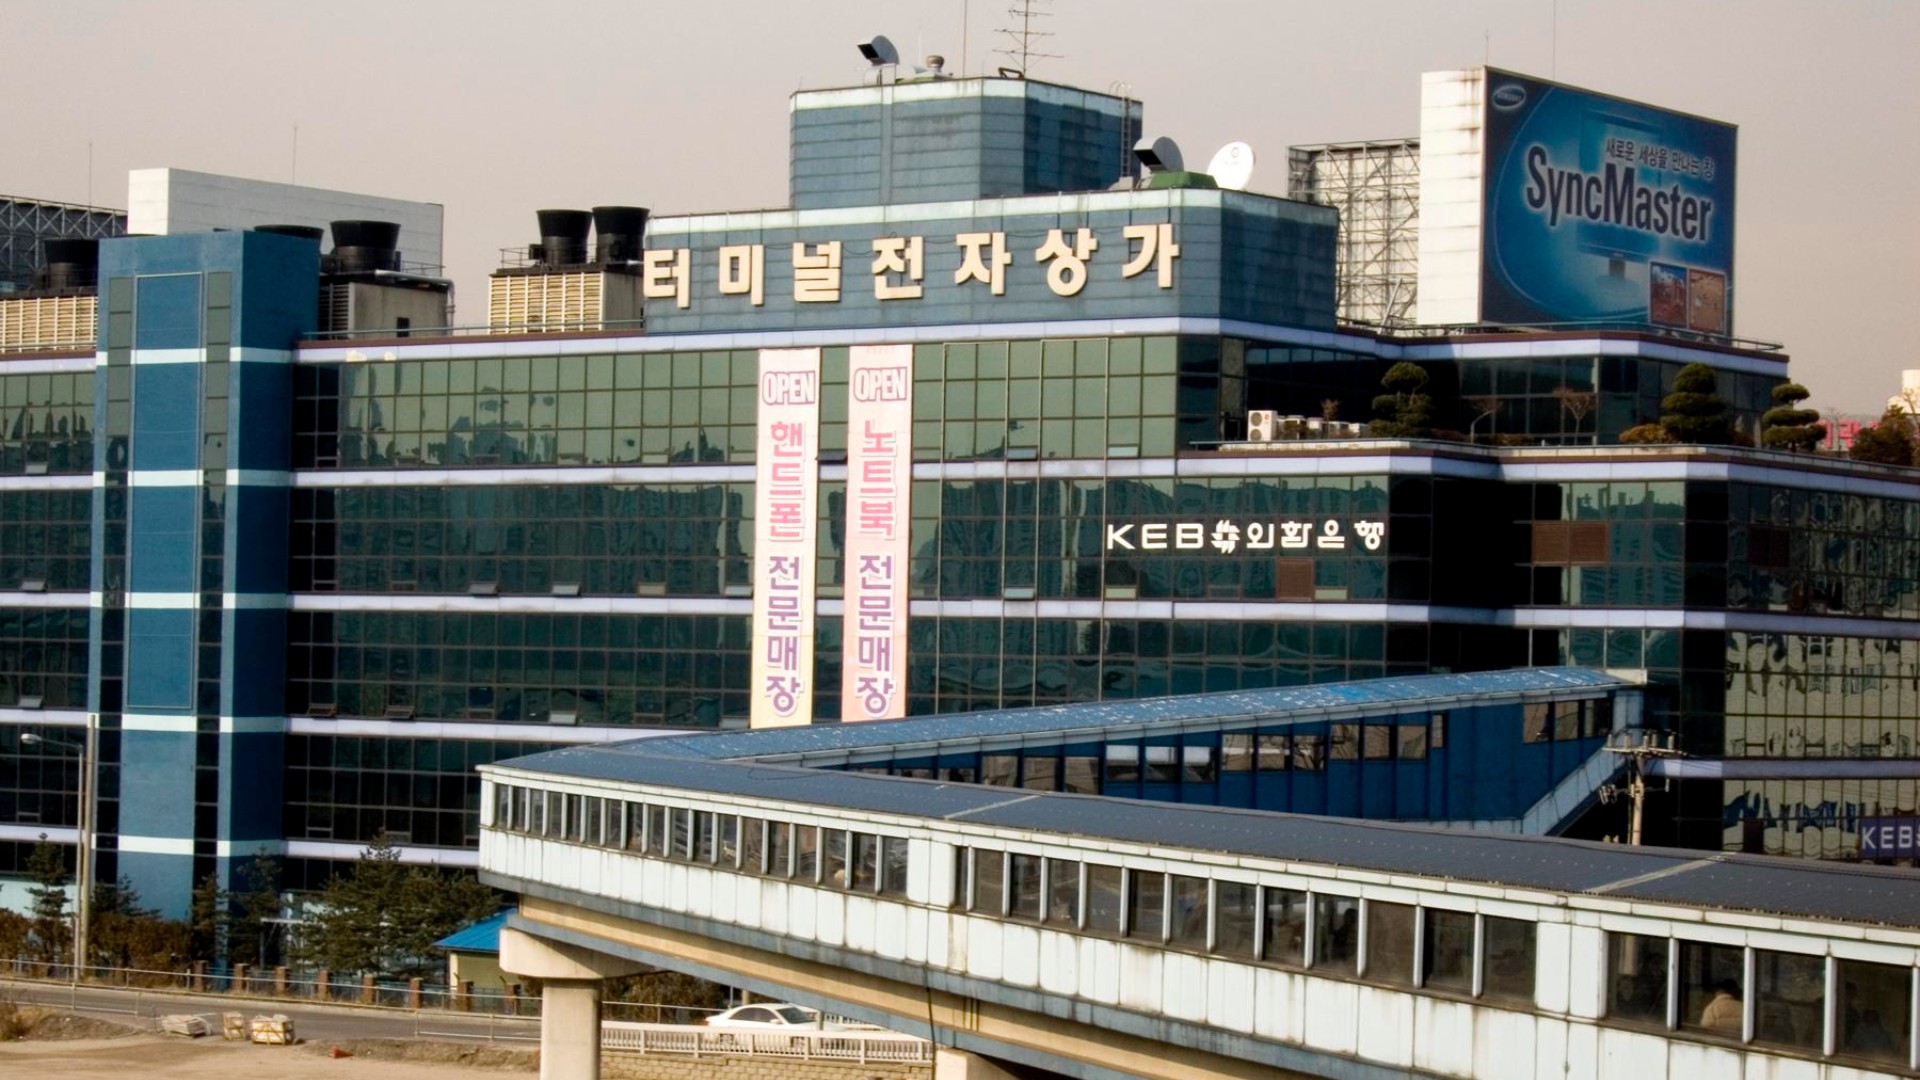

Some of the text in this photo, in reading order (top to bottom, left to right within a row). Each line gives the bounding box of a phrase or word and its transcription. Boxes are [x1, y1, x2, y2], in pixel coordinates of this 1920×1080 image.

[1605, 138, 1635, 162] 새로운
[1639, 145, 1668, 170] 세상을
[1671, 150, 1700, 176] 만나는
[1526, 145, 1713, 241] SyncMaster
[762, 370, 816, 405] OPEN
[853, 366, 908, 402] OPEN
[1107, 519, 1385, 550] KEB 외환은행
[766, 421, 803, 712] 핸드폰 전문매장
[857, 420, 894, 714] 노트북 전문매장
[1861, 826, 1913, 850] KEB
